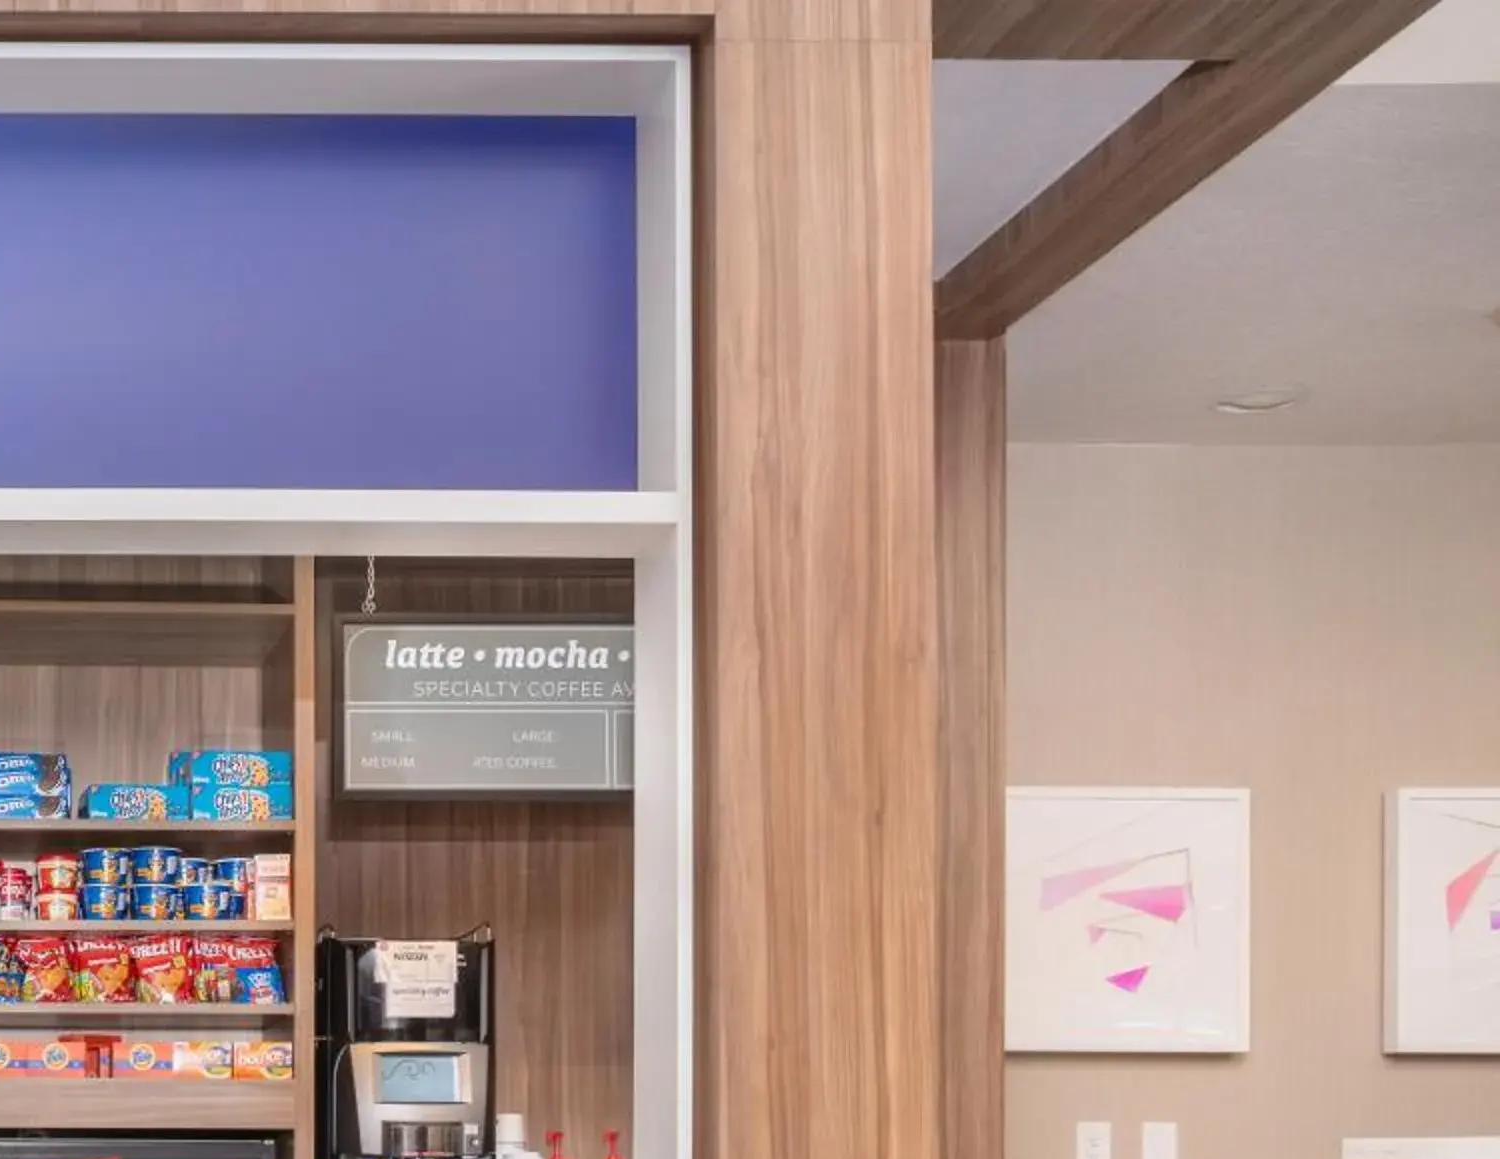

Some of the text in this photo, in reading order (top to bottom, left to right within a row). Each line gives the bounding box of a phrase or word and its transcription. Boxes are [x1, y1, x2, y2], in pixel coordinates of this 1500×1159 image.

[385, 639, 609, 669] latte mocha
[413, 680, 521, 697] SPECIALTY
[526, 680, 605, 697] COFFEE
